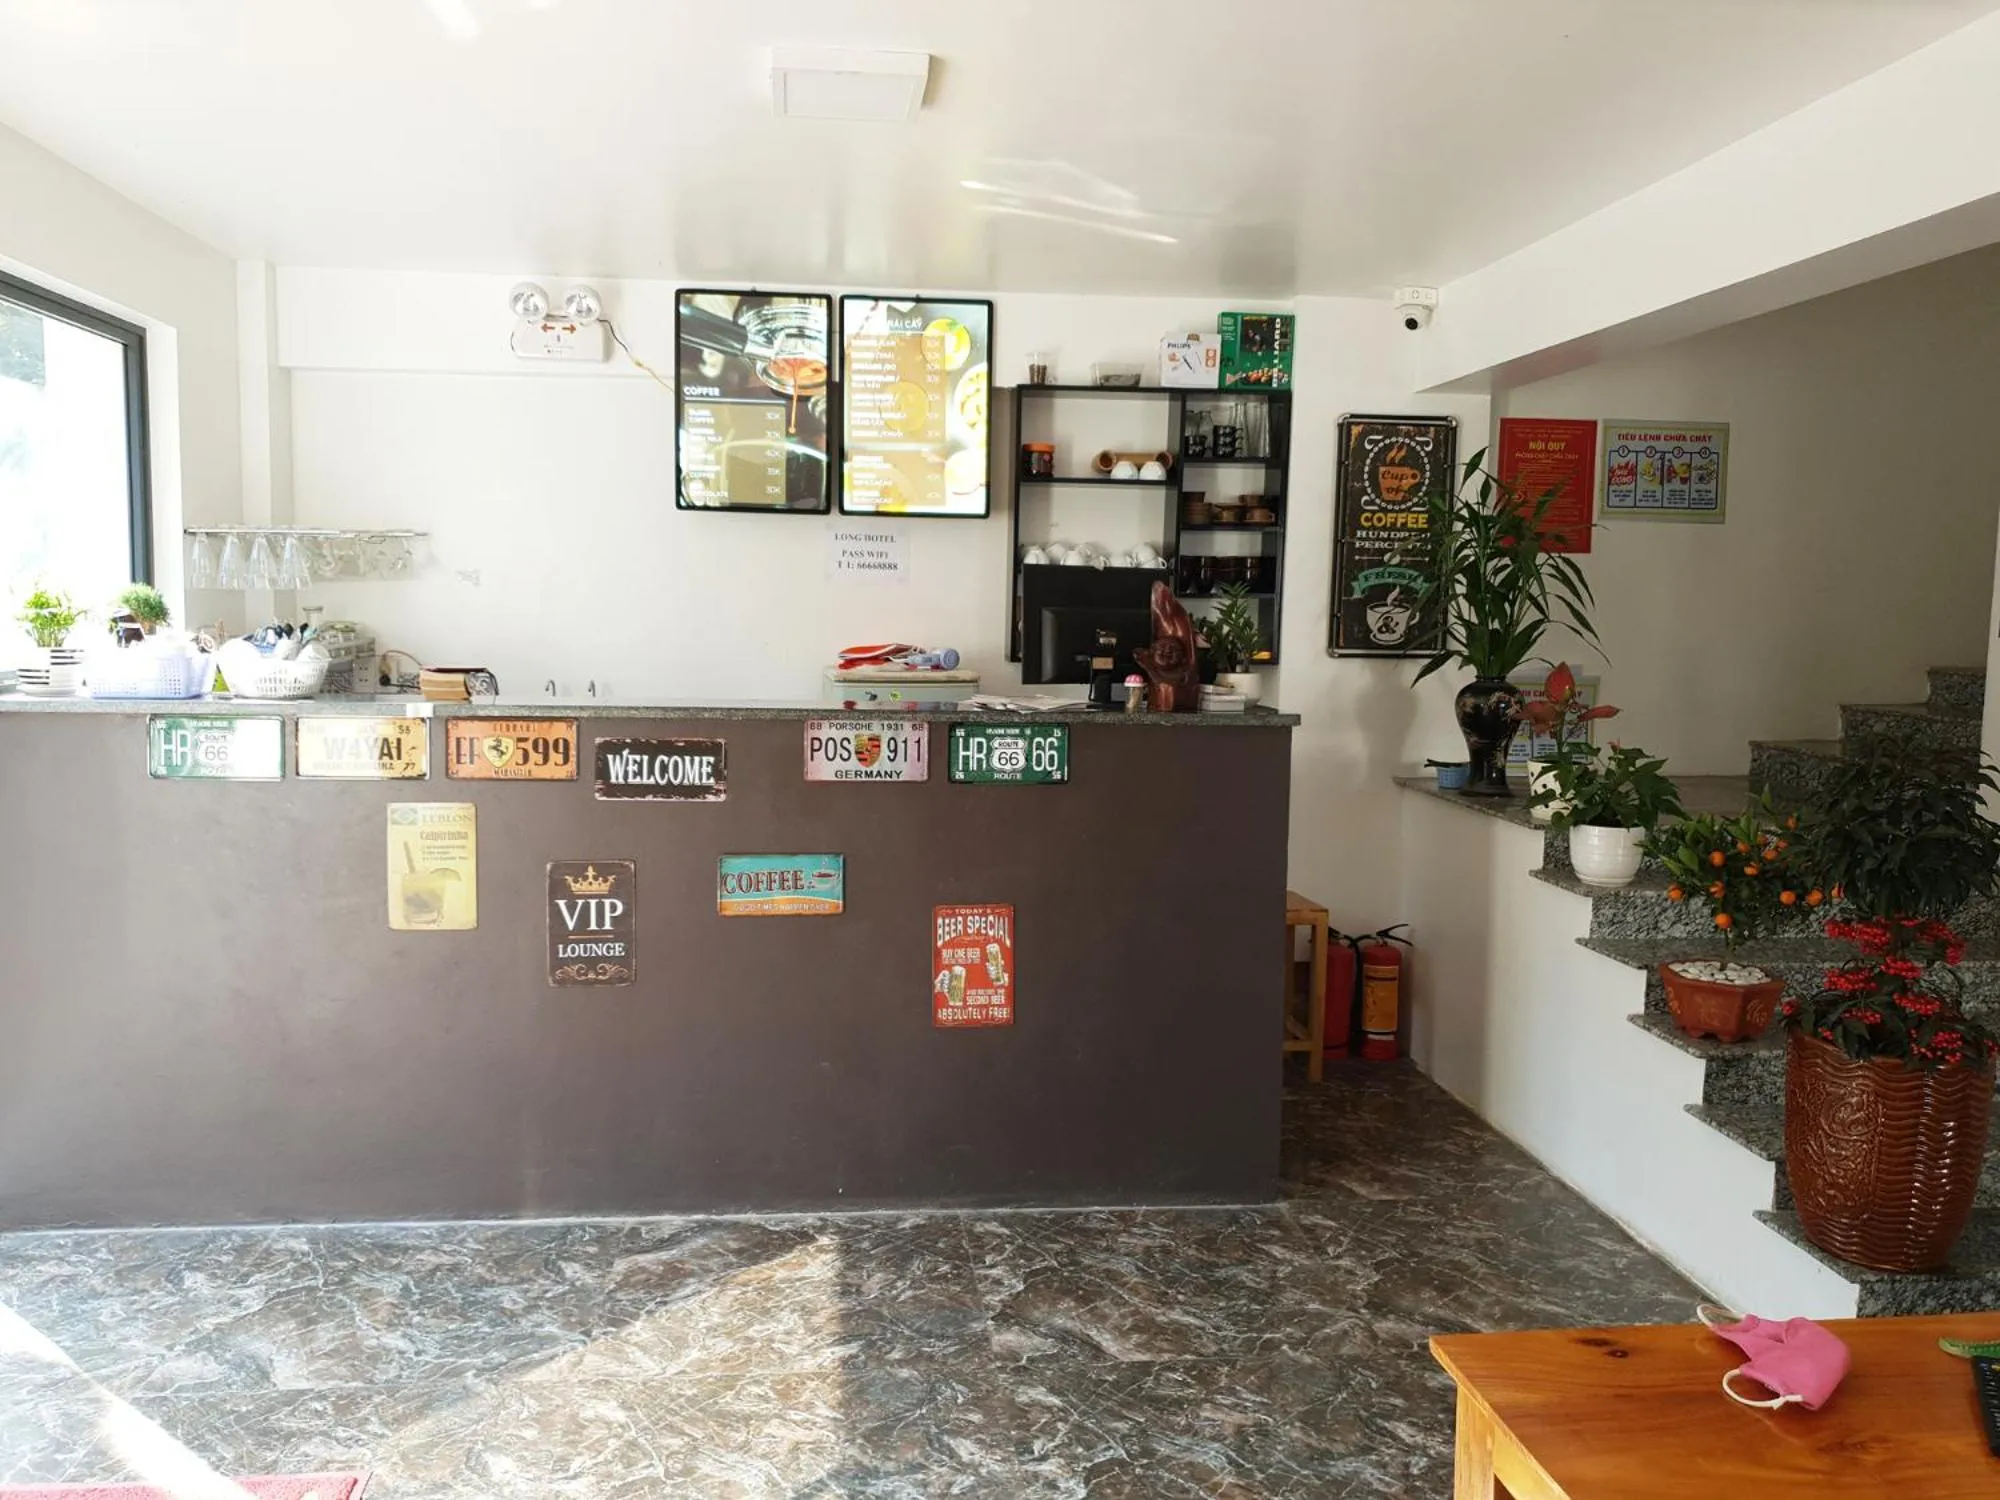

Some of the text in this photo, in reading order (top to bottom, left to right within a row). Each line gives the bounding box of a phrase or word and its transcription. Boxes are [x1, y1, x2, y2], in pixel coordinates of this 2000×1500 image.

[1382, 470, 1409, 481] Cup
[1360, 512, 1429, 528] COFFEE
[835, 533, 896, 543] LONG HOTEL
[829, 722, 874, 731] PORSCHE
[881, 723, 904, 731] 1931
[204, 745, 228, 761] 66
[515, 737, 570, 767] 599
[810, 737, 921, 762] POS 911
[959, 737, 987, 771] HR
[1033, 737, 1058, 771] 66
[998, 751, 1019, 766] 66
[606, 748, 716, 786] WELCOME
[835, 770, 903, 779] GERMANY
[721, 870, 805, 894] COFFEE
[554, 898, 624, 931] VIP
[937, 915, 1010, 948] BEER SPECIAL
[557, 943, 626, 958] LOUNGE
[938, 1007, 987, 1020] ABSOLUTELY
